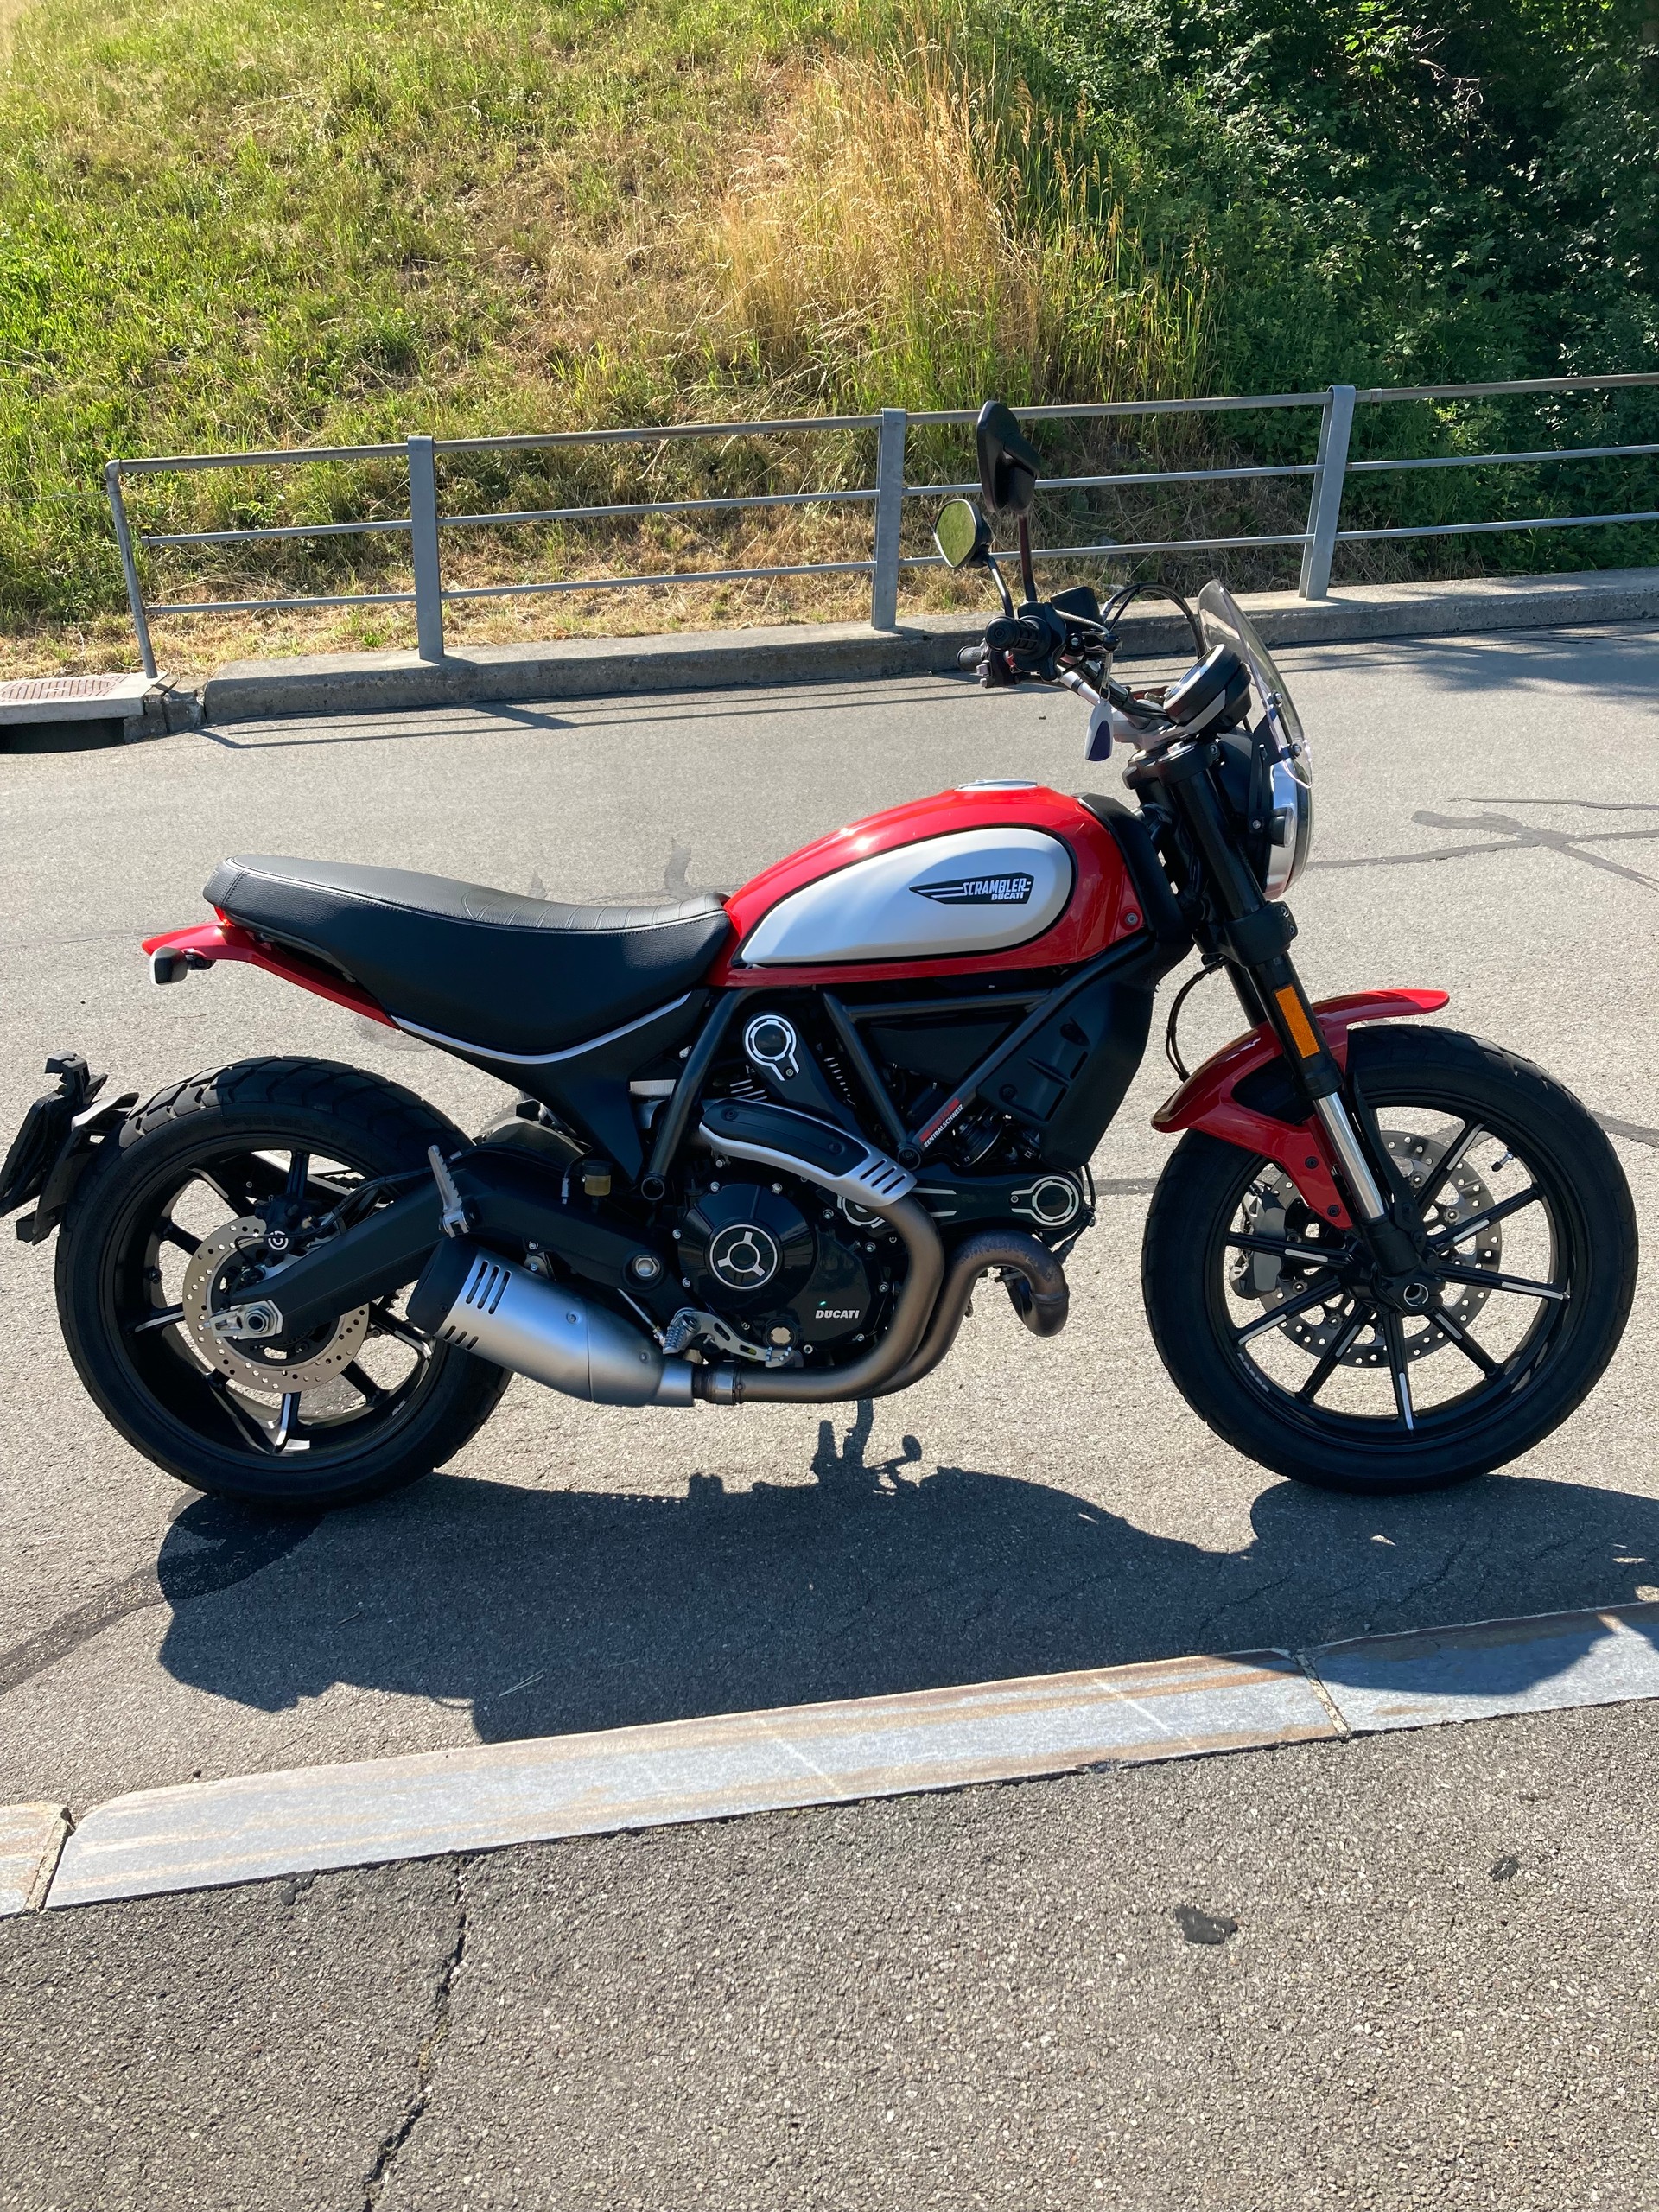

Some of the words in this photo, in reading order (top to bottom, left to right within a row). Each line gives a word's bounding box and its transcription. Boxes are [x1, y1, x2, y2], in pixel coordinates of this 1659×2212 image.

[962, 878, 1028, 896] SCRAMBLER
[991, 892, 1024, 901] DUCATI
[923, 1103, 964, 1148] ZENTRALSCHWEIZ
[815, 1309, 861, 1319] DUCATI
